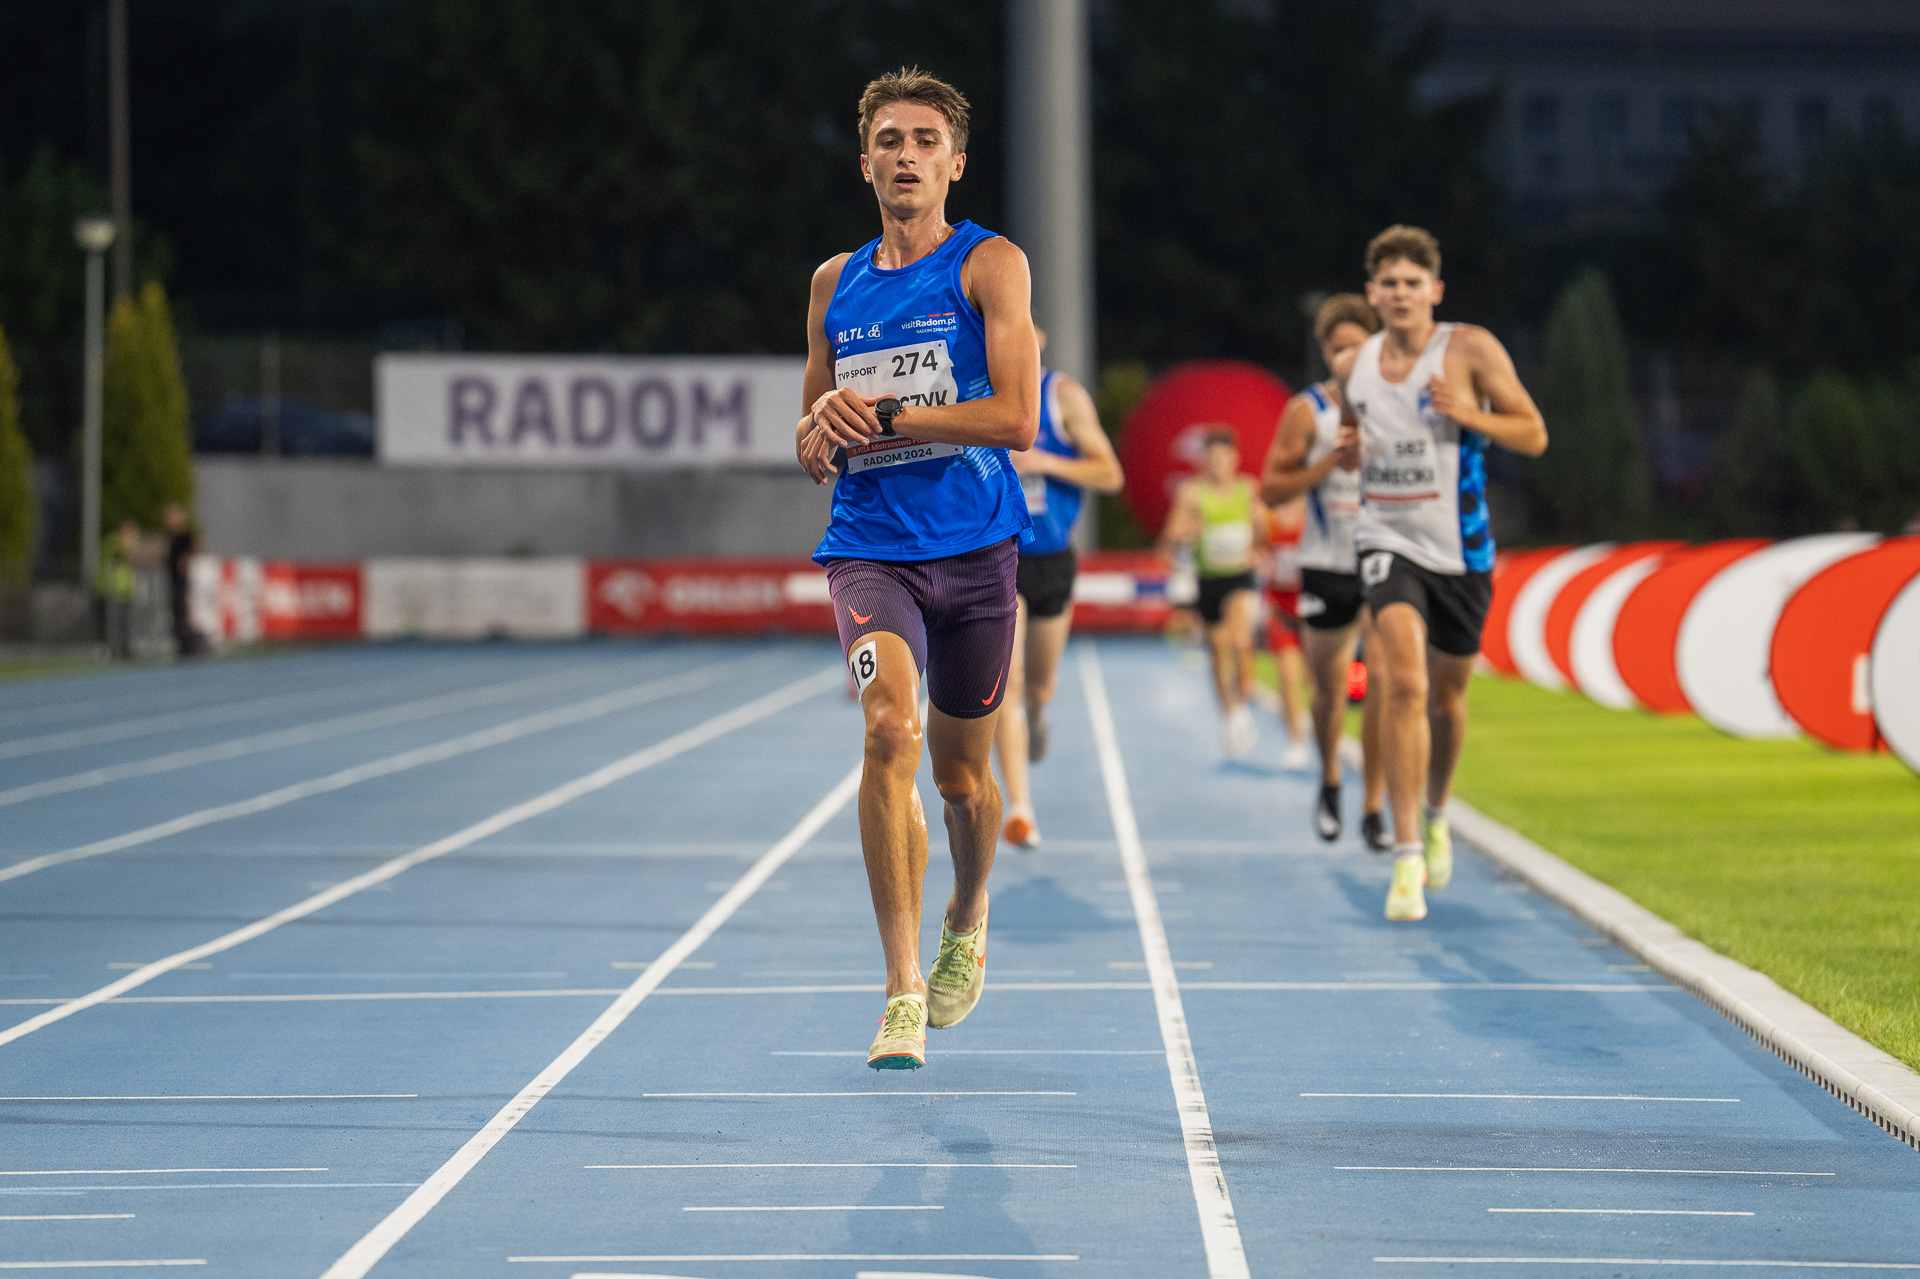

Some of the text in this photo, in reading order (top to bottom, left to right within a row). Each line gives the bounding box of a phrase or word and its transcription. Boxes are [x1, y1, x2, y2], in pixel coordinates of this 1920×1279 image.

[901, 316, 957, 330] visitRadom.pl
[838, 366, 877, 382] TVP SPORT
[891, 350, 938, 378] 274
[447, 375, 752, 451] RADOM
[863, 447, 933, 467] RADOM 2024
[851, 649, 875, 690] 18
